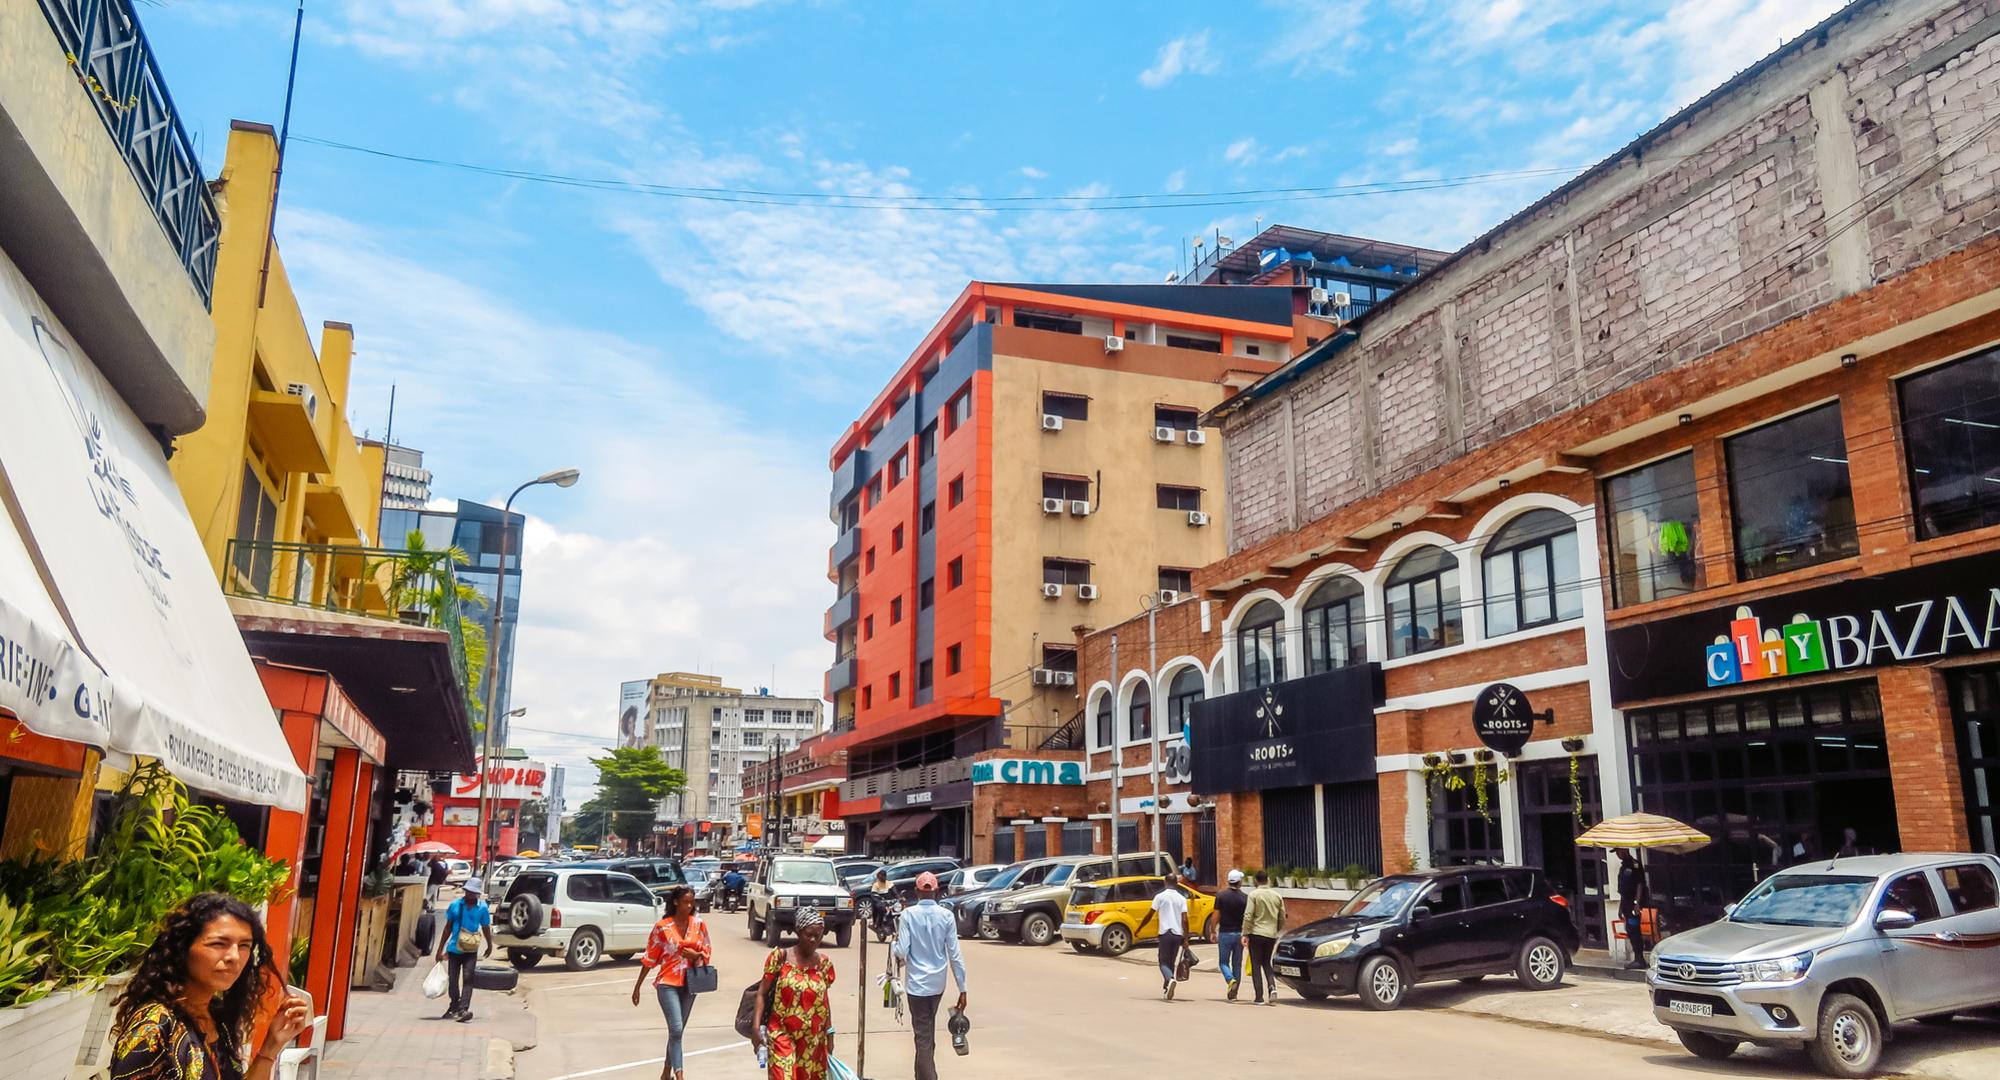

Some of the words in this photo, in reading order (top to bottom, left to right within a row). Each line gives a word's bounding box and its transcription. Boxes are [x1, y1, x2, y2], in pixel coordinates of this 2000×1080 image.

[1707, 632, 1812, 682] CITY
[1488, 719, 1521, 729] ROOTS
[1254, 743, 1288, 761] ROOTS
[1001, 760, 1082, 784] cma
